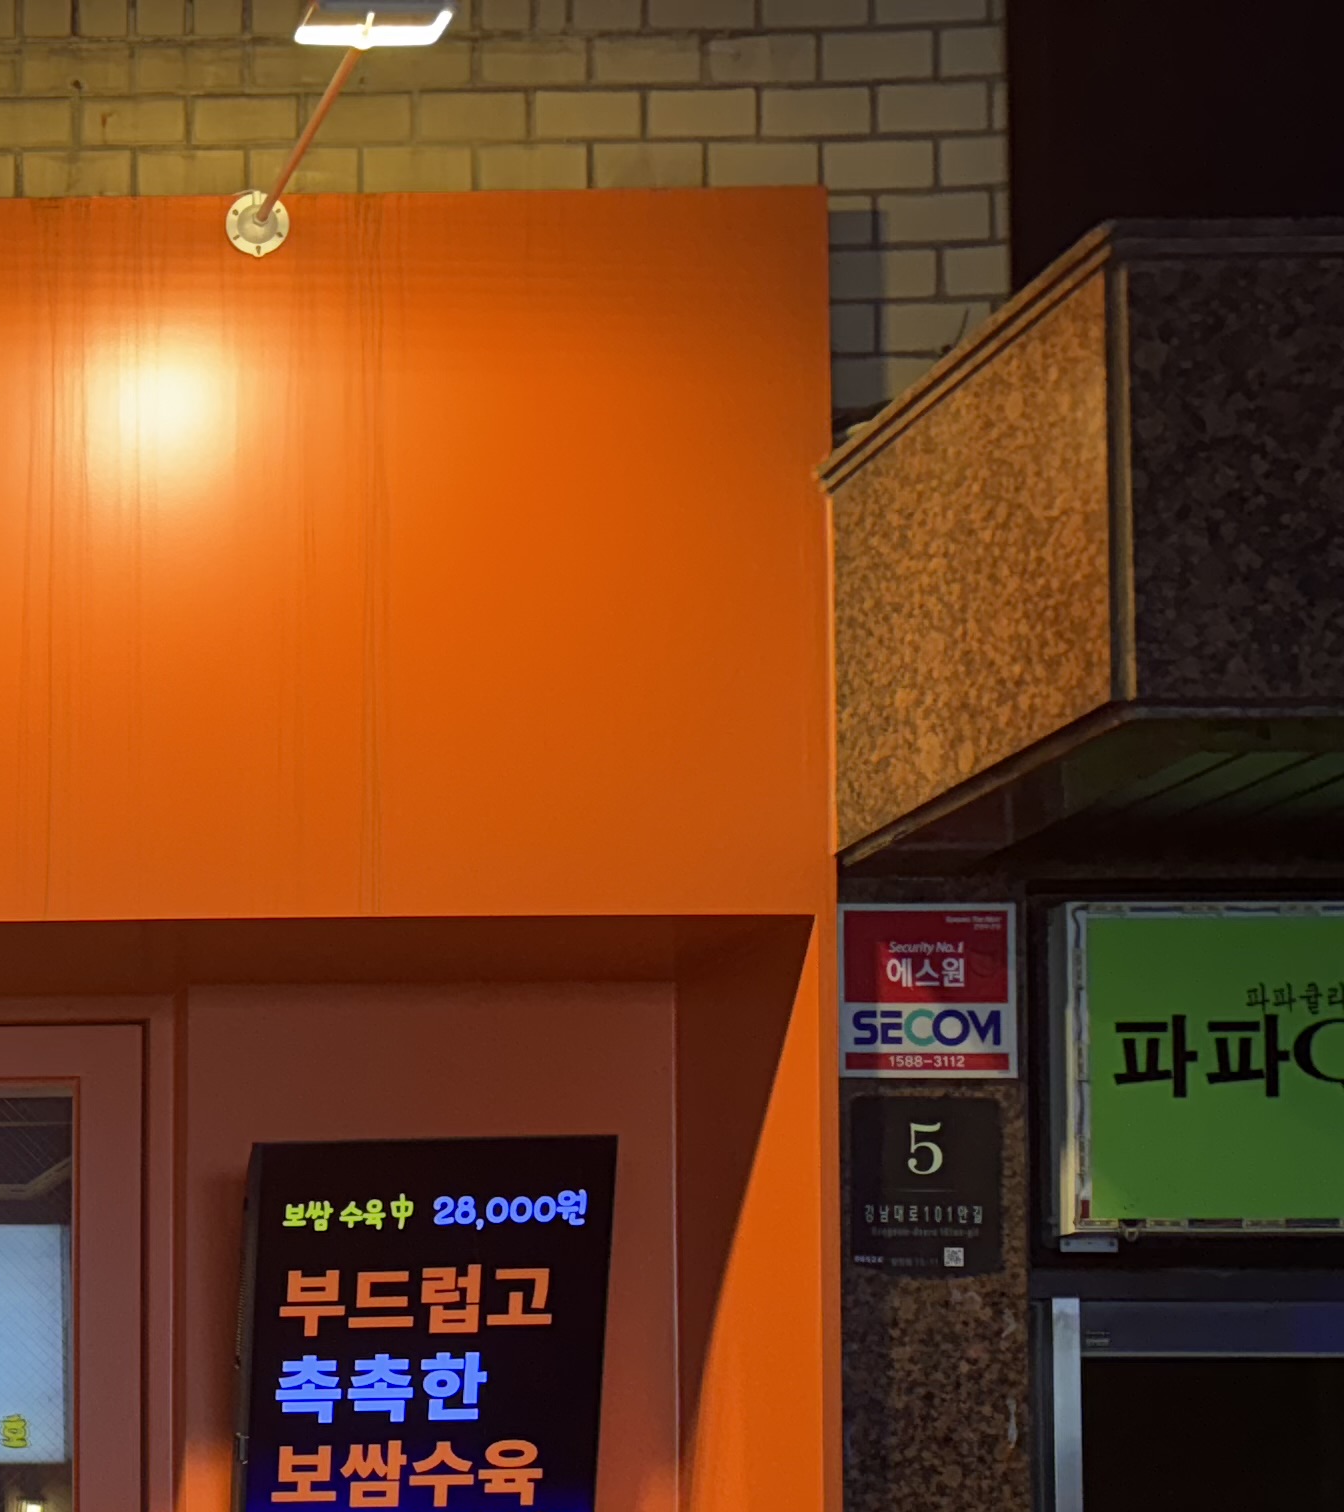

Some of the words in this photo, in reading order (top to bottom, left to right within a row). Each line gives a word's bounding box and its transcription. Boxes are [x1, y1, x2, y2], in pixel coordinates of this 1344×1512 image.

[889, 941, 935, 955] Security
[886, 957, 965, 987] 에스원
[852, 1008, 1001, 1046] SECOM
[889, 1055, 965, 1068] 1588-3112
[907, 1122, 943, 1175] 5
[282, 1201, 334, 1231] 보쌈
[339, 1201, 386, 1230] 수육
[433, 1189, 588, 1231] 28,000원
[279, 1264, 552, 1337] 부드럽고
[275, 1351, 487, 1423] 촉촉한
[271, 1439, 543, 1508] 보쌈수육
